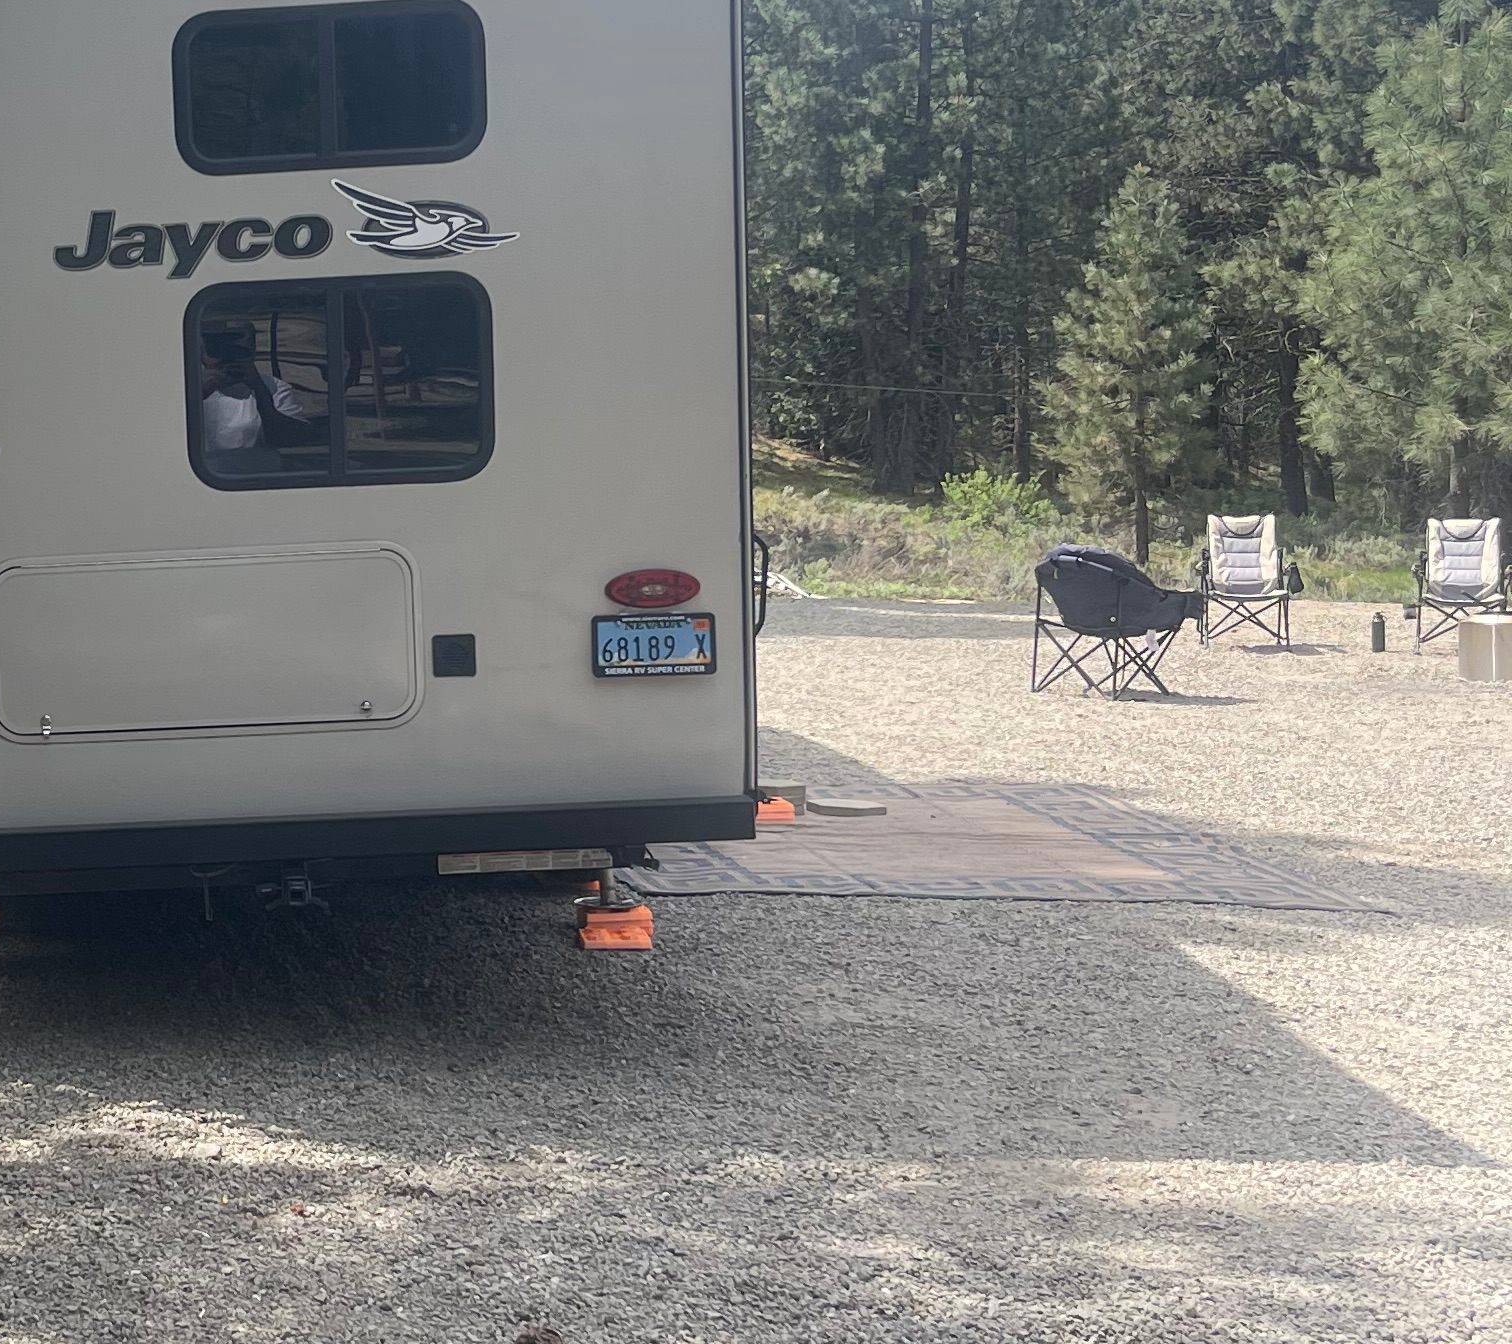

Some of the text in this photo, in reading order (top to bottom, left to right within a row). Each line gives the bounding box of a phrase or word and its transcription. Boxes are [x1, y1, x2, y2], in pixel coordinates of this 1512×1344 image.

[53, 209, 333, 279] Jayco
[624, 621, 683, 631] NEVADA
[602, 634, 707, 663] 68189 X
[605, 667, 633, 675] SIERRA
[647, 666, 673, 674] SUPER
[674, 665, 705, 673] CENTER
